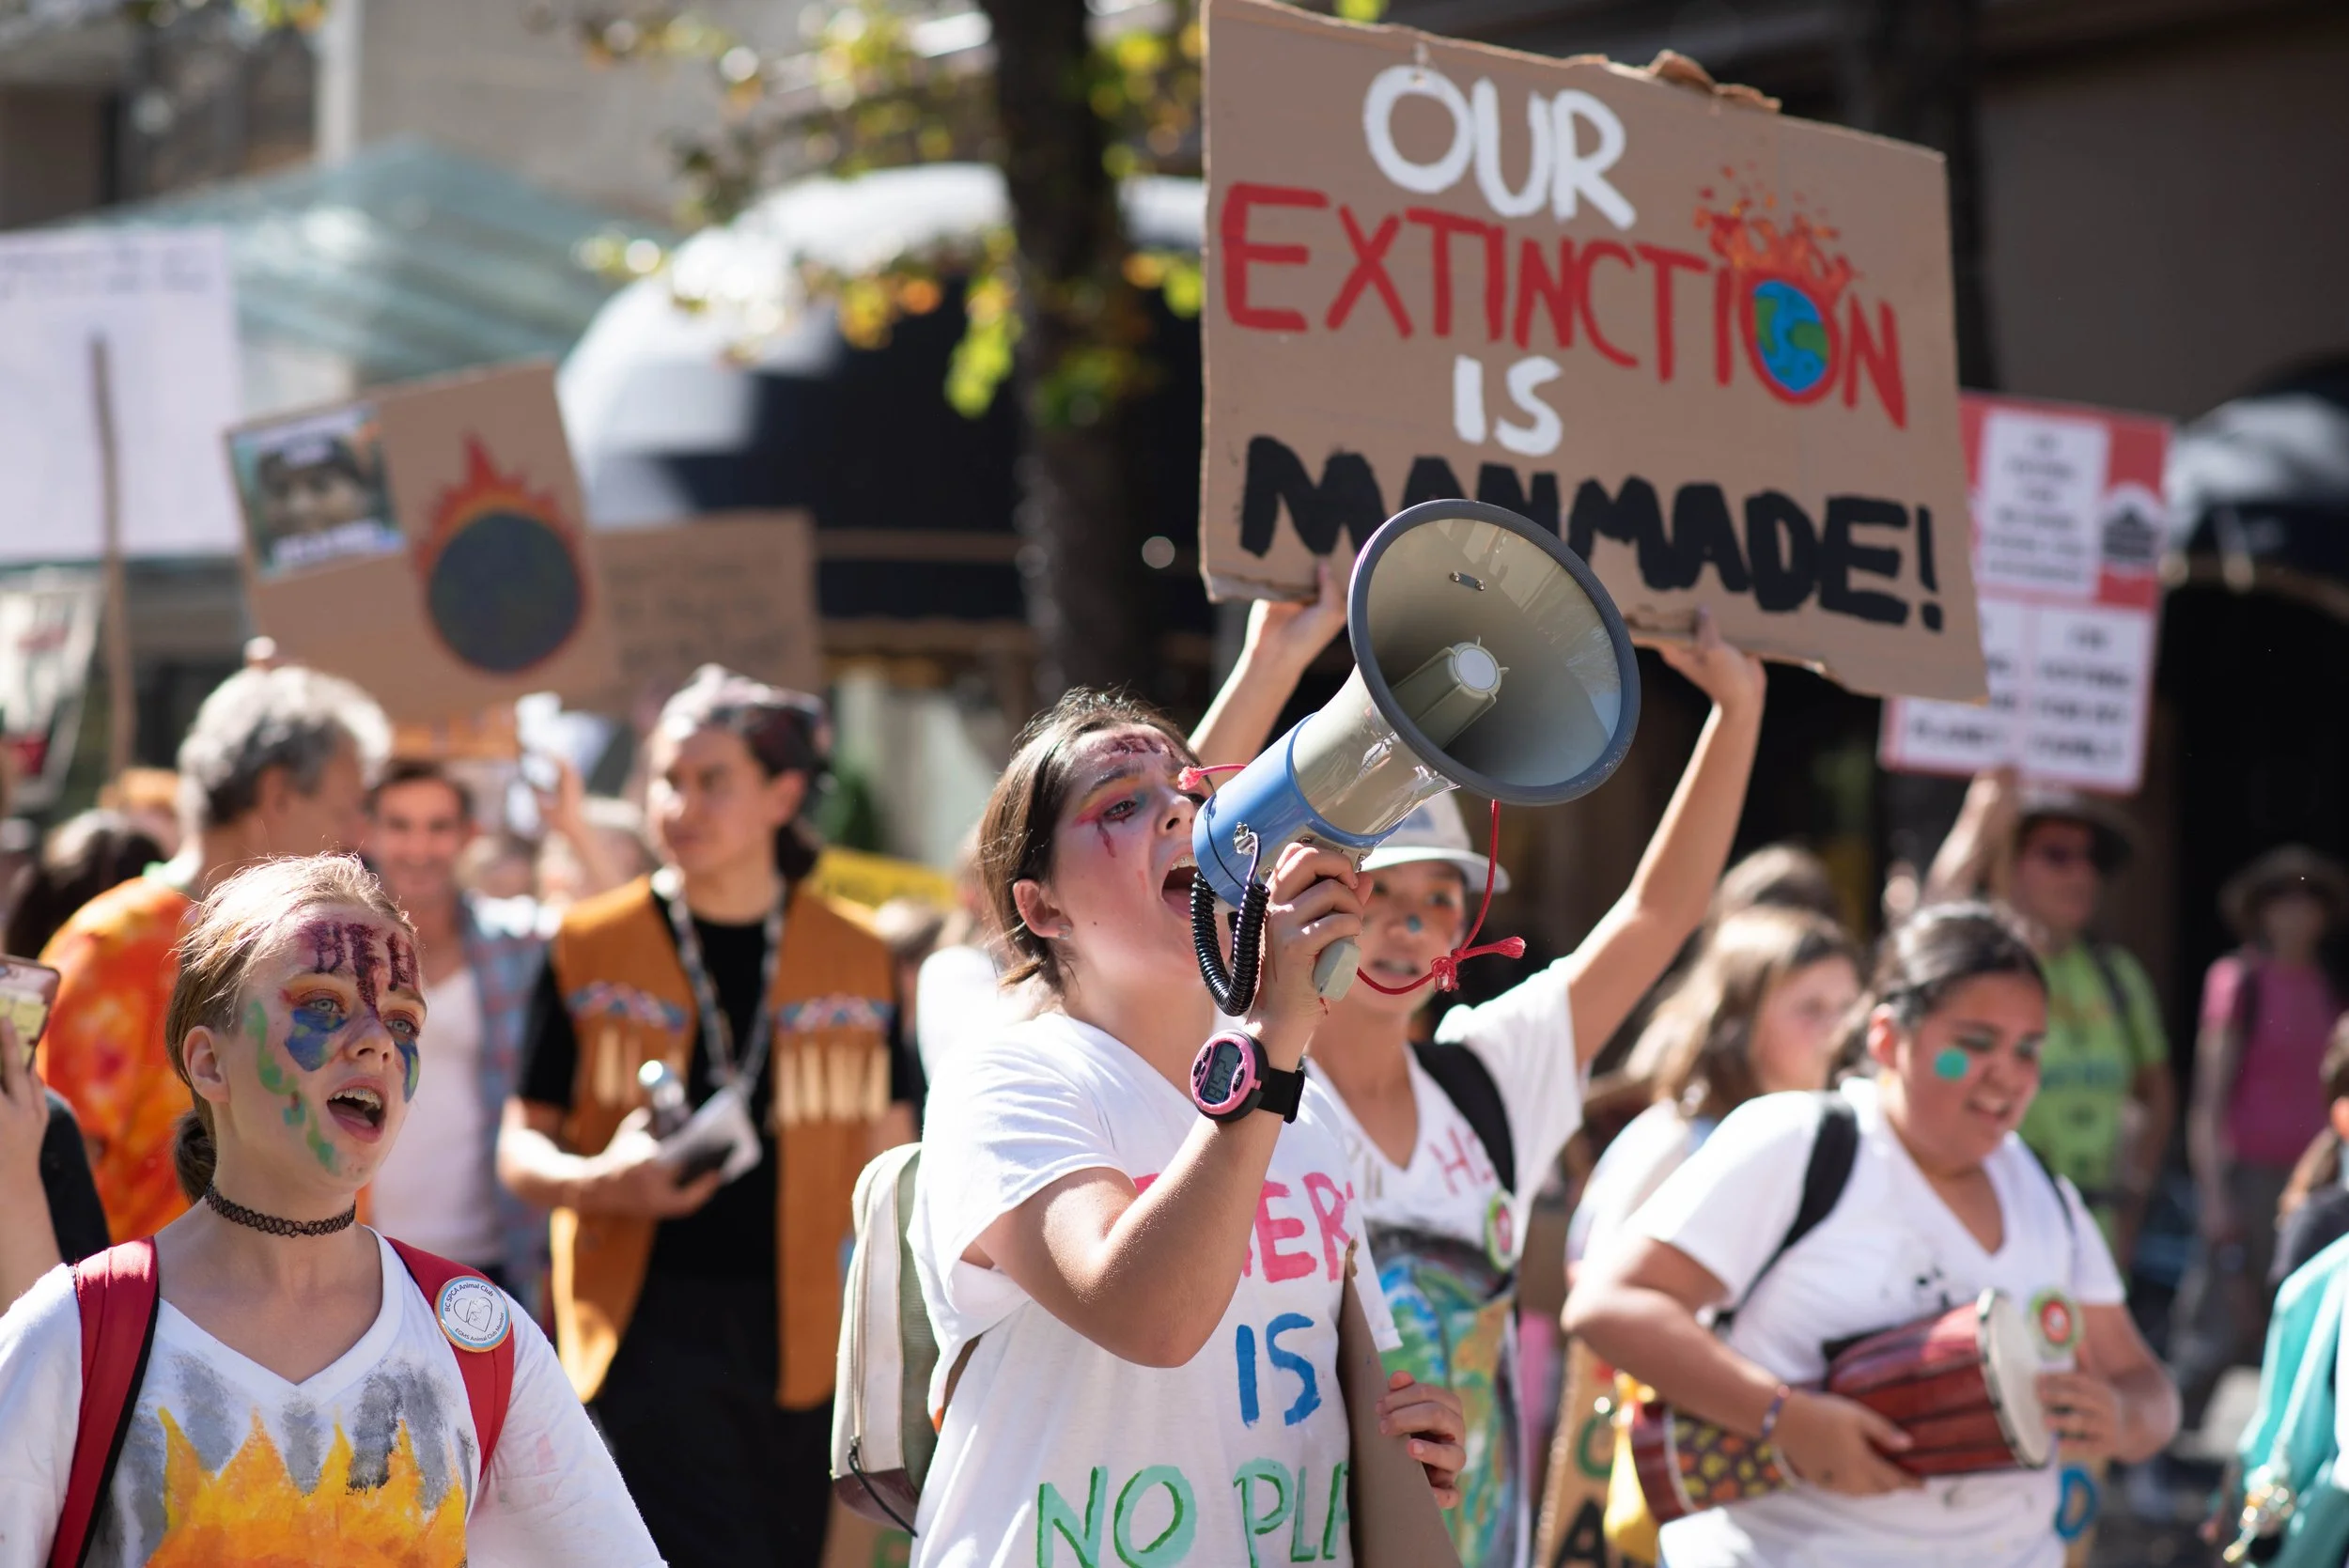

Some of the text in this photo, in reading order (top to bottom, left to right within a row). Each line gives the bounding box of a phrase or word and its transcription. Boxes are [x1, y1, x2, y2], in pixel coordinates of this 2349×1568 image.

[1362, 63, 1637, 231] OUR
[1220, 181, 1906, 429] EXTINCTION
[1453, 353, 1563, 458] IS
[444, 1282, 494, 1312] BC SPCA Animal Club
[488, 1331, 497, 1340] Club
[1236, 1312, 1322, 1428] IS
[1037, 1465, 1197, 1568] NO
